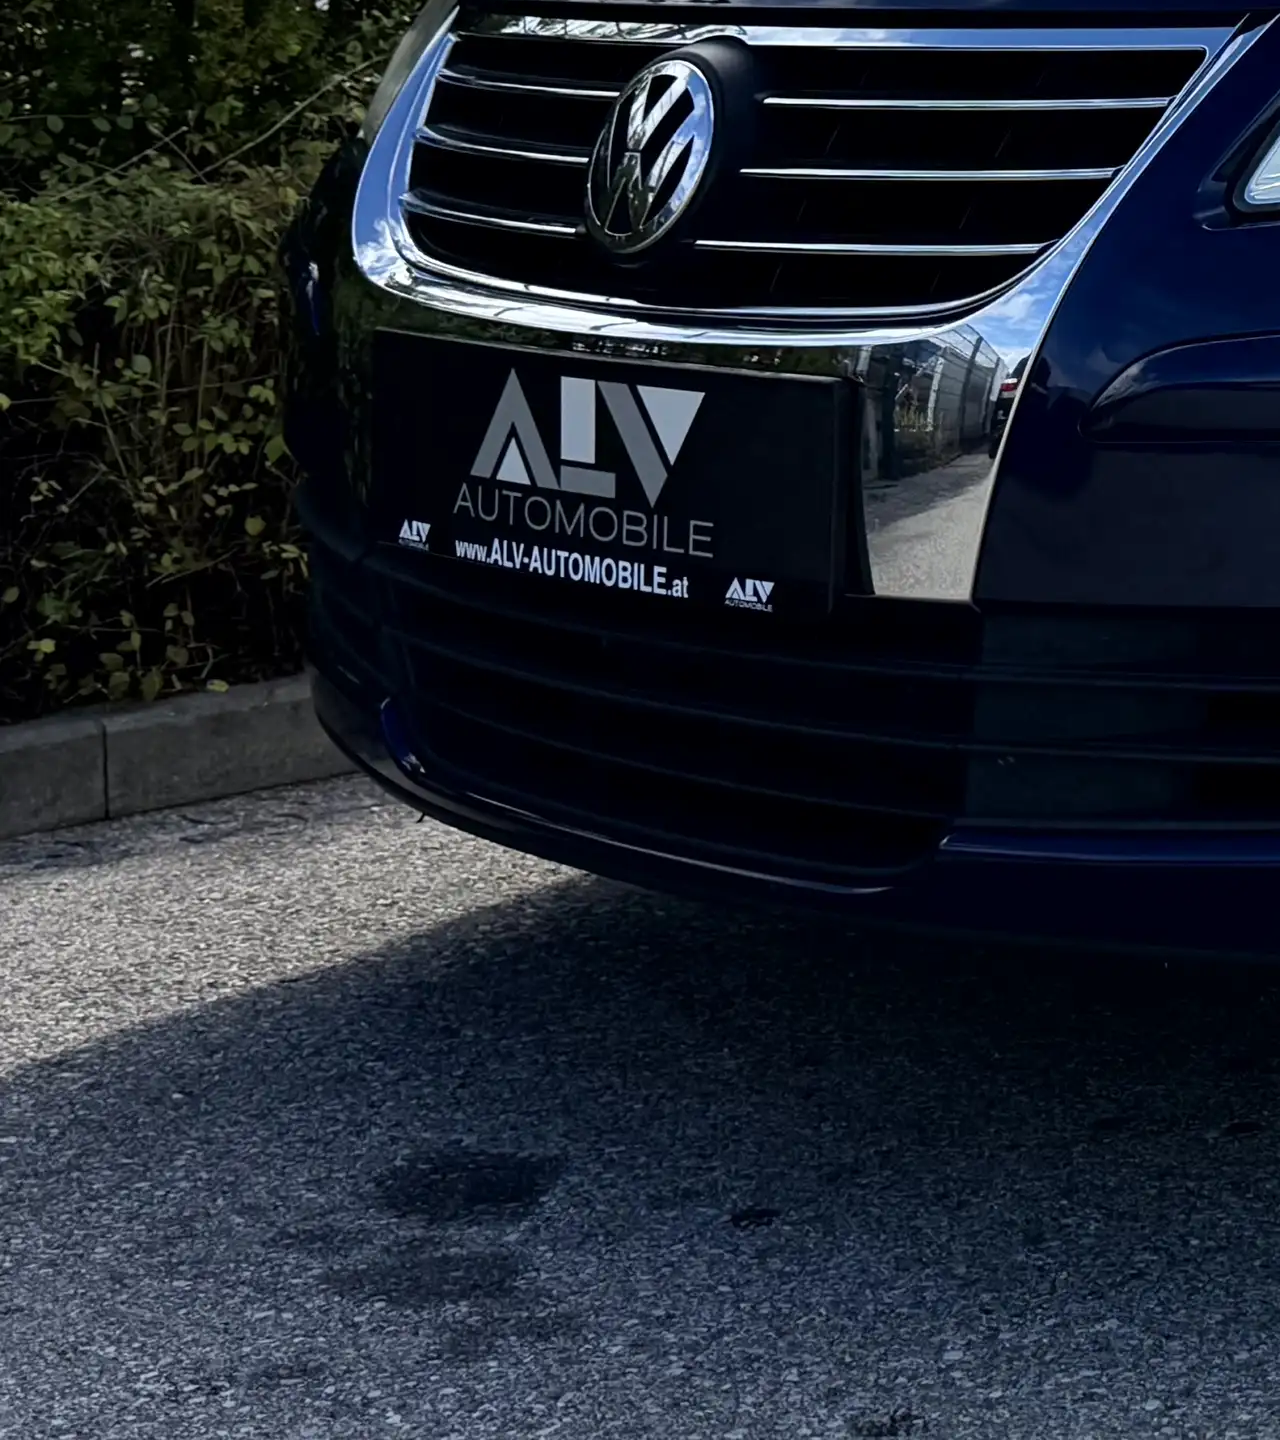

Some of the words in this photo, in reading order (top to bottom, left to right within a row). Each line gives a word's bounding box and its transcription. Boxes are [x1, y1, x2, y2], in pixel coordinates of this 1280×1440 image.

[470, 367, 706, 509] ALV
[398, 518, 431, 543] ALV
[453, 482, 714, 558] AUTOMOBILE
[455, 537, 690, 599] www.ALV-AUTOMOBILE.at
[725, 577, 775, 604] ALV
